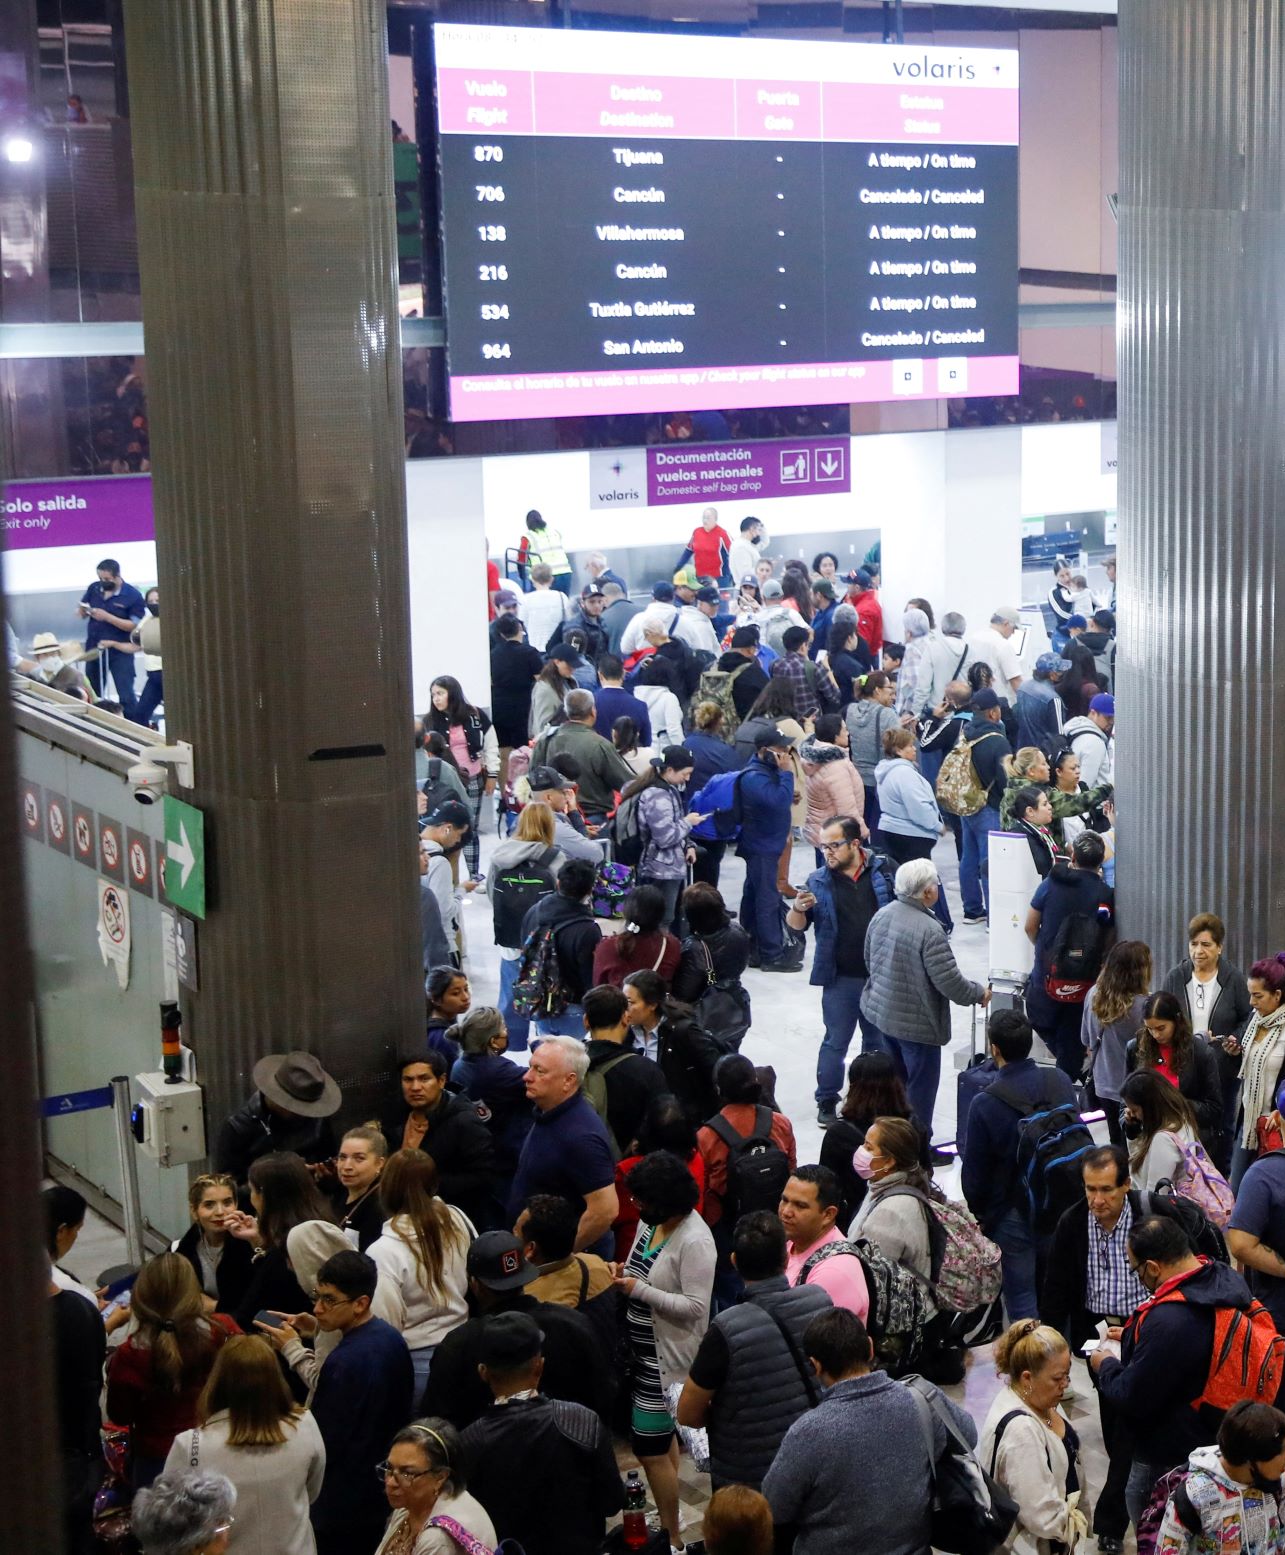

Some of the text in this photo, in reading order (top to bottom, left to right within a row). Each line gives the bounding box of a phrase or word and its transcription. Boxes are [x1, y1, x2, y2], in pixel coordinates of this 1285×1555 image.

[893, 55, 975, 79] volaris
[465, 80, 507, 97] Vuelo
[610, 84, 663, 102] Destino
[467, 107, 508, 127] Flight
[600, 111, 674, 128] Destination
[475, 146, 503, 162] 870
[612, 148, 664, 167] Tijuana
[868, 153, 880, 168] A
[880, 153, 921, 170] tiempo
[931, 154, 948, 168] On
[950, 154, 976, 168] time
[476, 186, 505, 202] 706
[613, 187, 665, 203] Cancún
[860, 189, 922, 203] Cancelado
[931, 189, 984, 204] Canceled
[478, 226, 507, 241] 138
[596, 225, 684, 241] Villahermosa
[869, 225, 880, 240] A
[881, 225, 922, 242] tiempo
[932, 225, 948, 239] On
[950, 225, 976, 239] time
[479, 265, 508, 281] 216
[616, 263, 667, 279] Cancún
[870, 261, 880, 275] A
[881, 260, 922, 277] tiempo
[932, 260, 948, 274] On
[950, 260, 976, 274] time
[589, 301, 696, 317] Tuxtla Gutiérrez
[870, 297, 880, 311] A
[882, 296, 922, 313] tiempo
[932, 296, 949, 309] On
[950, 295, 976, 309] time
[481, 305, 509, 320] 534
[862, 331, 922, 346] Cancelado
[932, 329, 984, 345] Canceled
[482, 344, 511, 359] 964
[604, 339, 684, 355] San Antonio
[656, 449, 752, 466] Documentación
[656, 465, 763, 483] vuelos nacionales
[598, 490, 640, 502] volaris
[657, 480, 762, 496] Domestic self bag drop
[37, 494, 87, 512] salida
[24, 515, 51, 530] only
